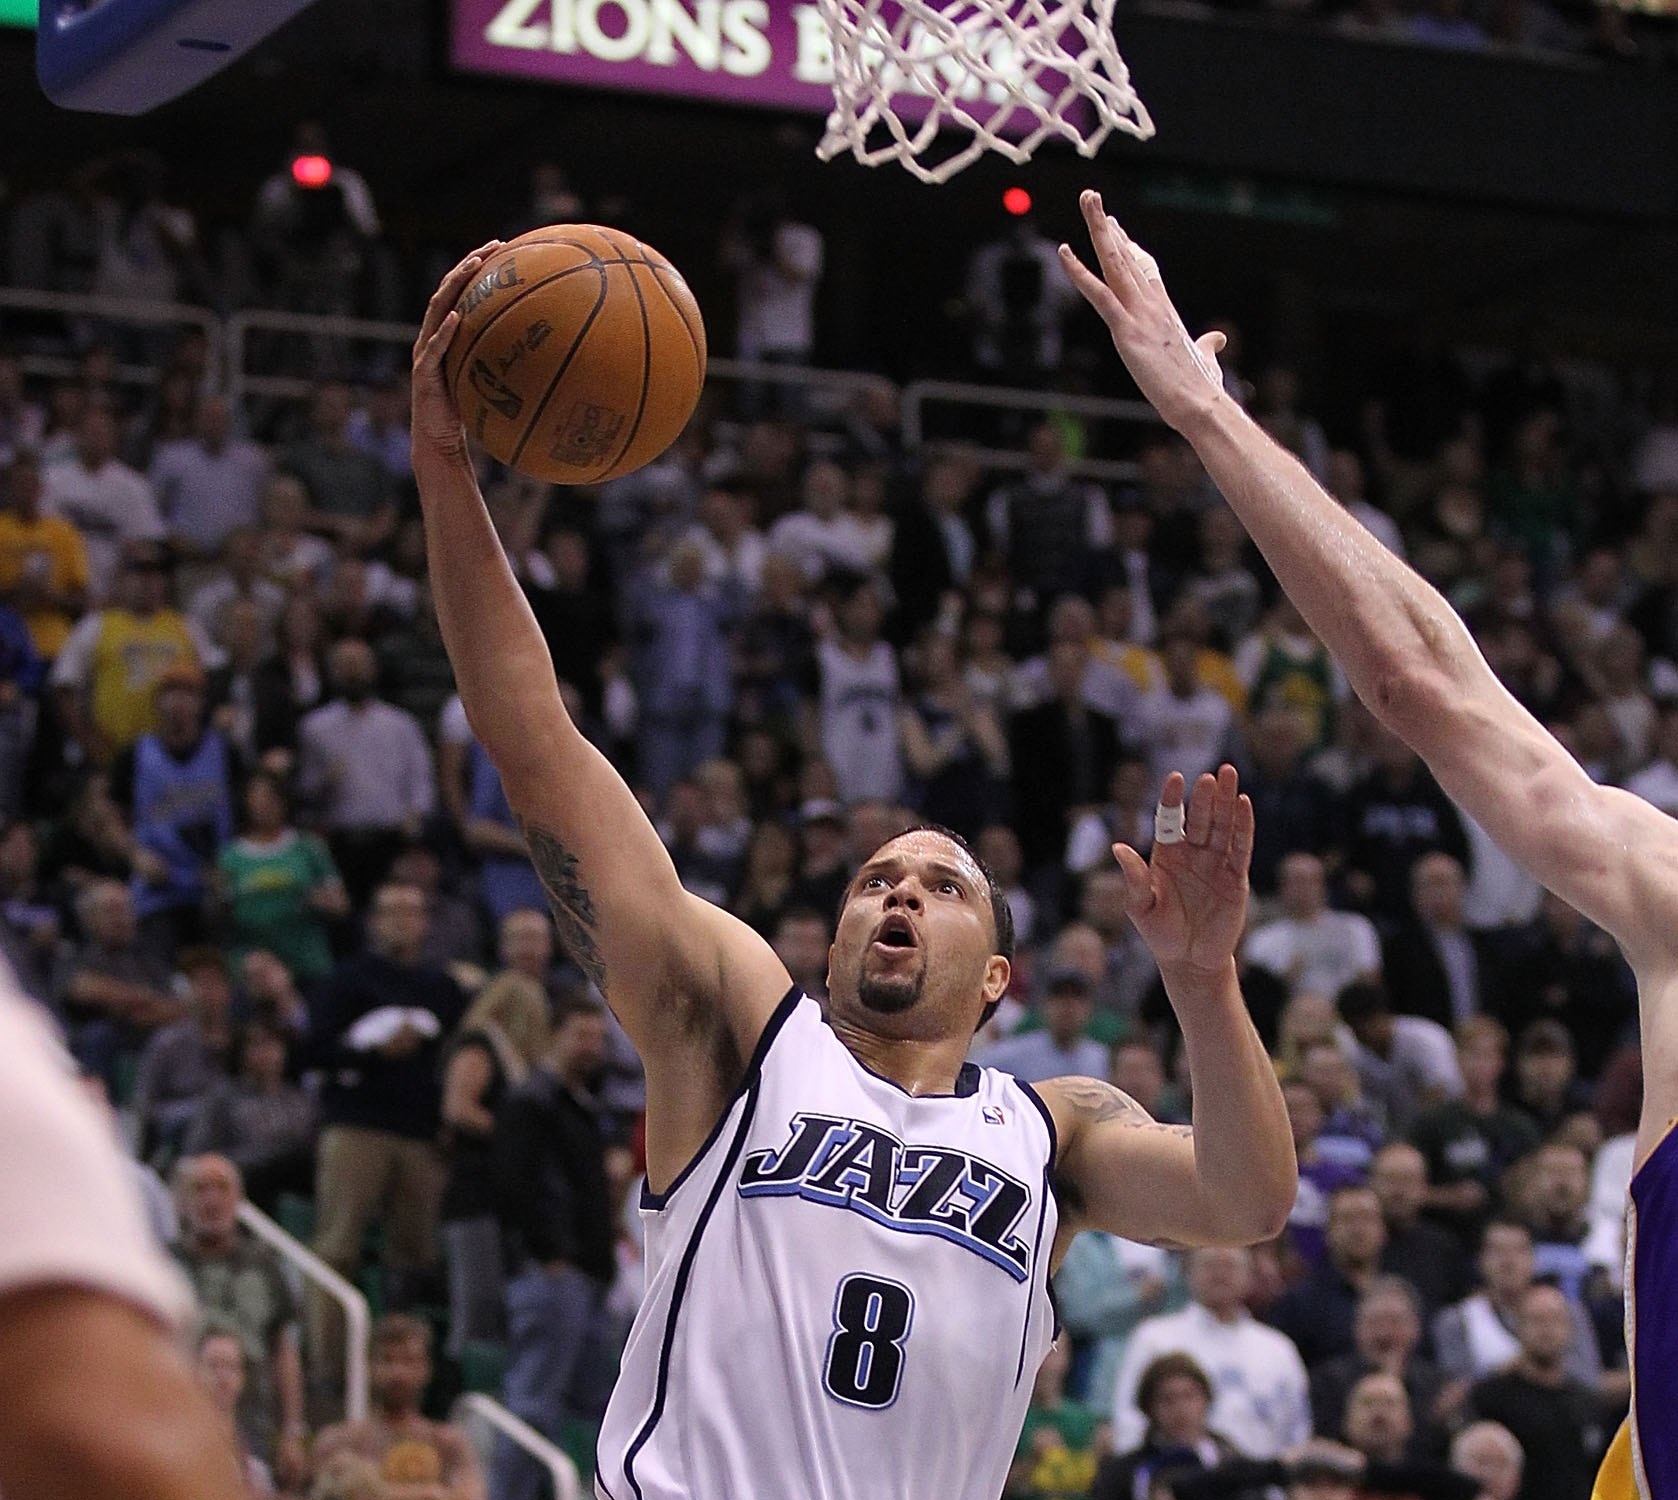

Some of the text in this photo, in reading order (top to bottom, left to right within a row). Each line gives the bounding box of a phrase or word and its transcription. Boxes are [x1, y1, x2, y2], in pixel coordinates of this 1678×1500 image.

[483, 0, 772, 77] ZIONS
[737, 1112, 1031, 1283] JAZZ
[821, 1271, 916, 1410] 8
